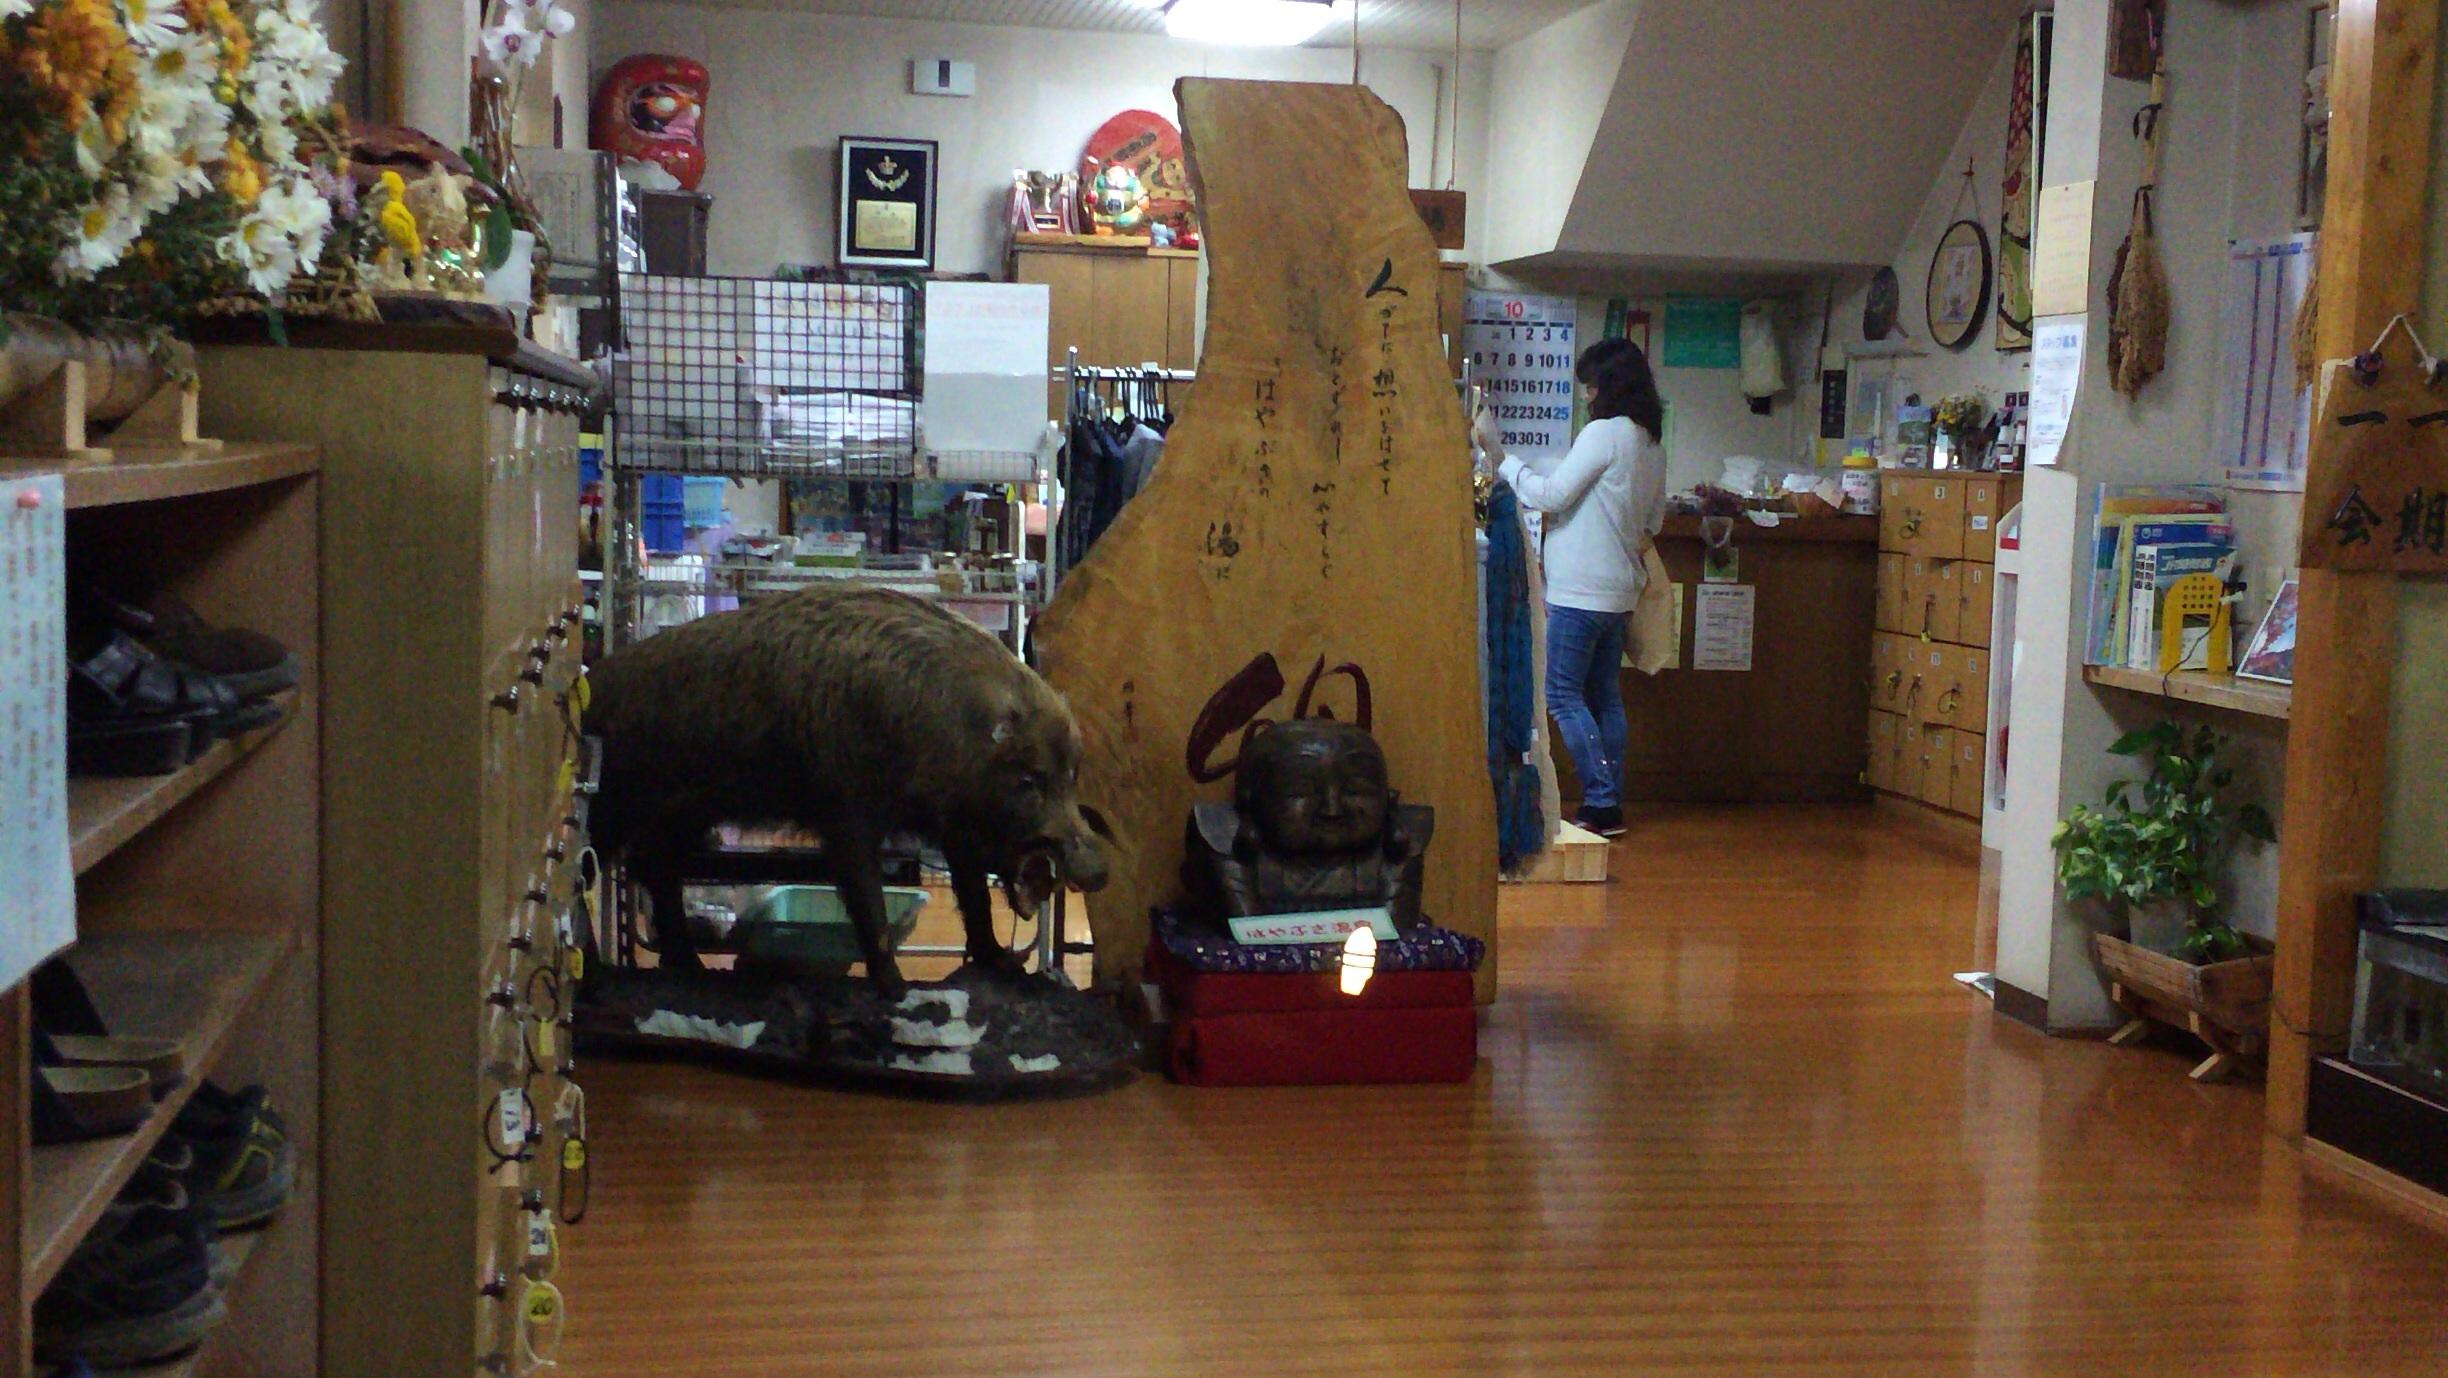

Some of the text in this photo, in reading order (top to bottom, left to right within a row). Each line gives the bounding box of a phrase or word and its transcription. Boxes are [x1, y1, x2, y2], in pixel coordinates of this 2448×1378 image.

[1504, 301, 1524, 319] 10
[1509, 327, 1516, 340] 1
[1525, 328, 1534, 341] 2
[1543, 328, 1551, 342] 3
[1560, 328, 1569, 342] 4
[1473, 352, 1570, 368] 6 7 8 9 10 11
[1486, 379, 1570, 394] 14 15 16 17 18
[1501, 405, 1518, 419] 22
[1518, 405, 1535, 420] 23
[1535, 406, 1552, 420] 24
[1552, 406, 1569, 420] 25
[1501, 430, 1550, 446] 29 30 31
